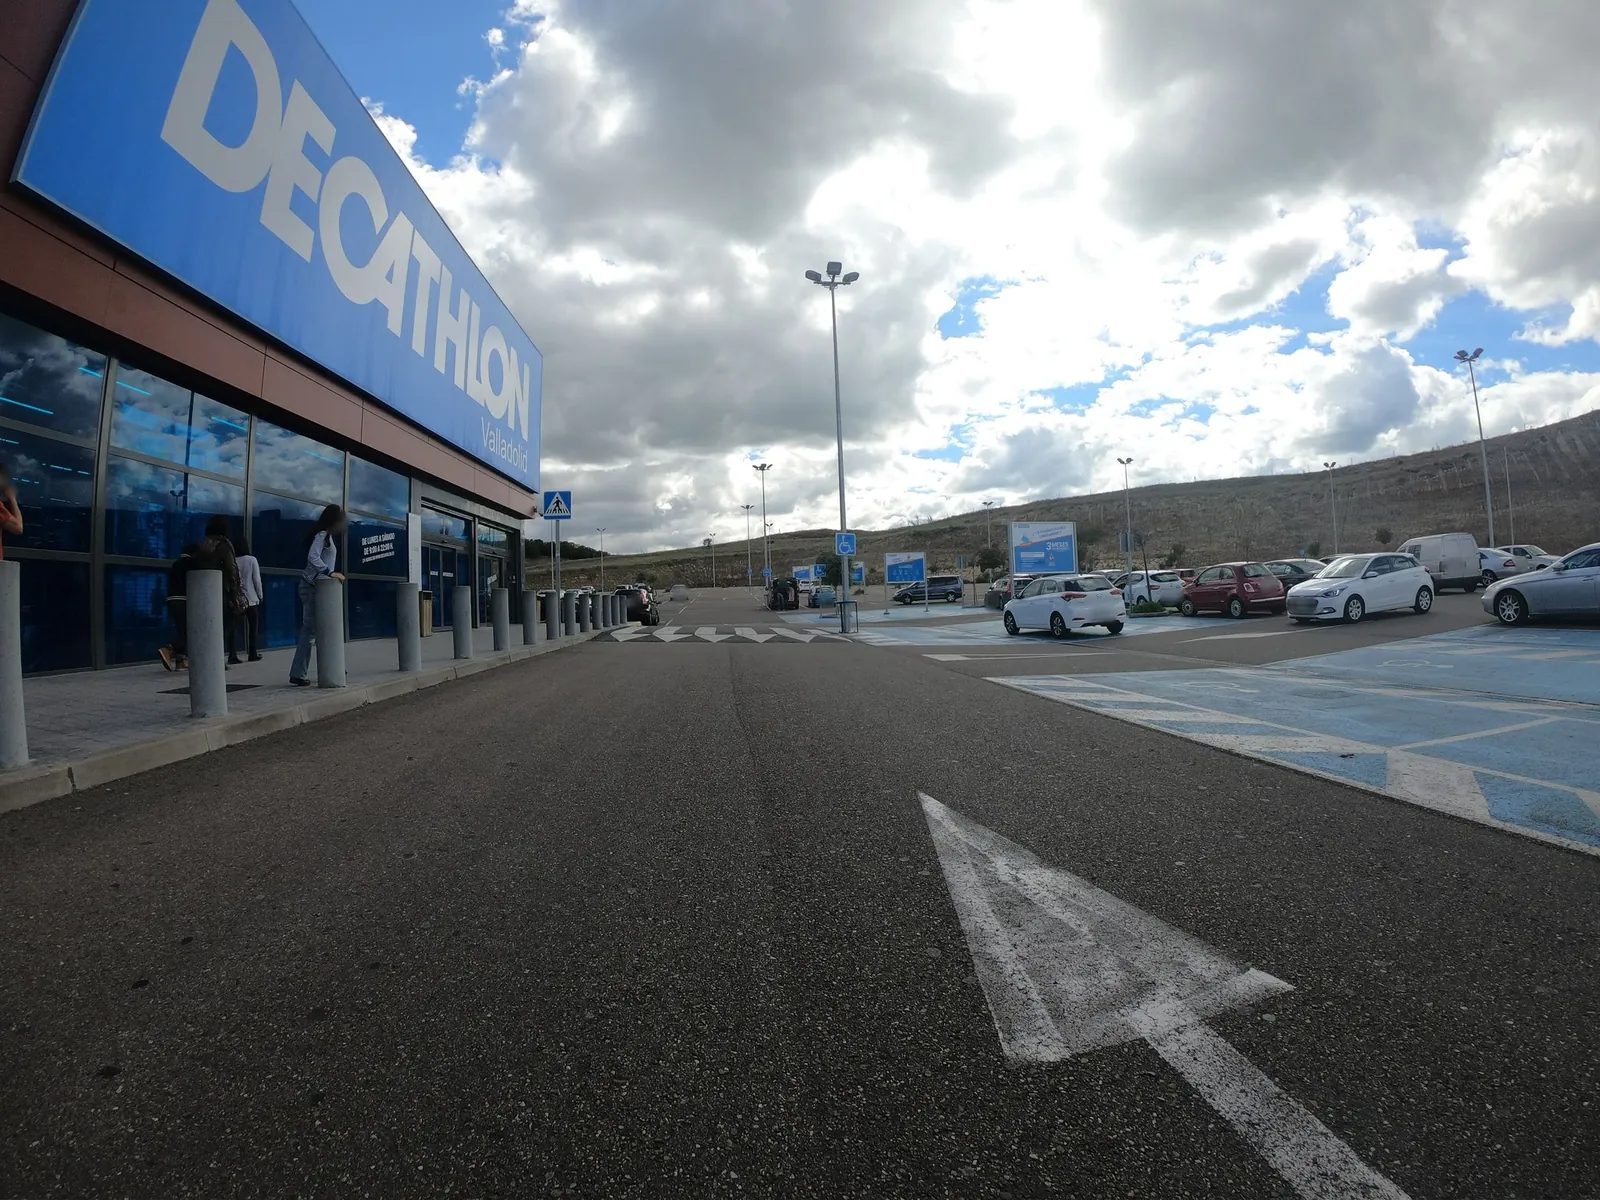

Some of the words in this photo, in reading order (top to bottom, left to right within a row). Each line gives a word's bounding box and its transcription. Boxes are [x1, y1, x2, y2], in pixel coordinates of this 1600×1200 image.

[161, 0, 530, 442] DECATHLON
[481, 416, 528, 473] Valladolid
[362, 538, 367, 546] DE
[367, 536, 378, 544] LUNES
[1046, 541, 1051, 551] 3
